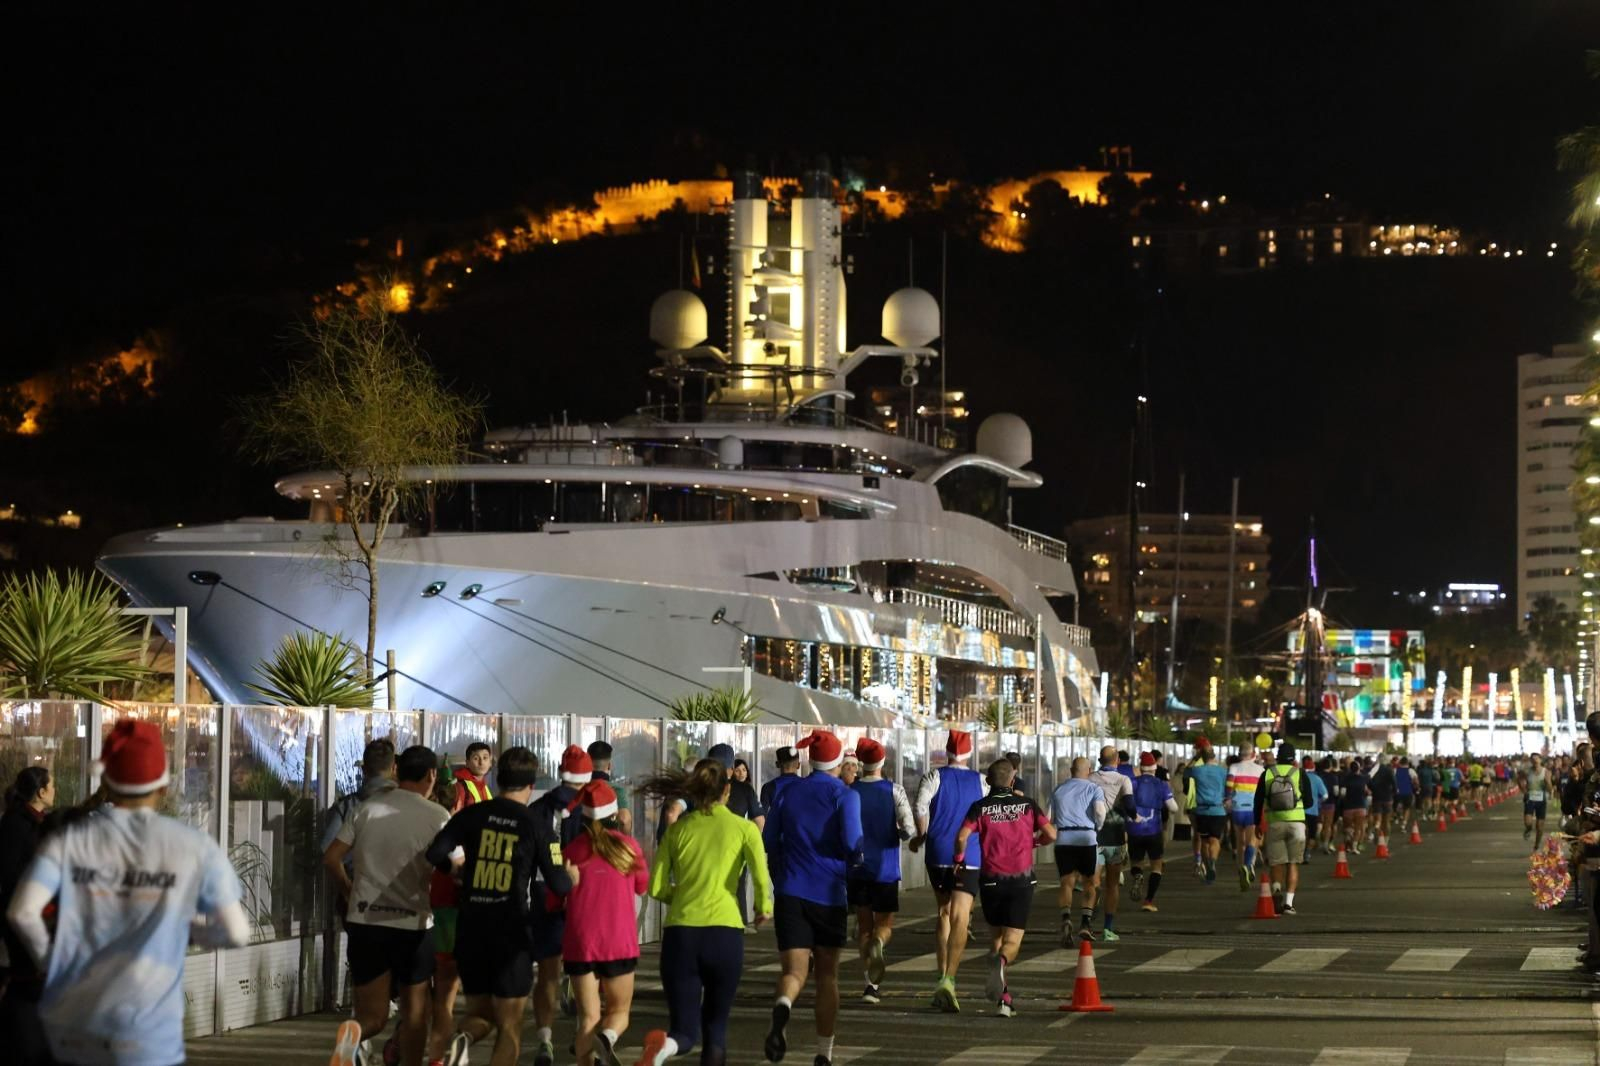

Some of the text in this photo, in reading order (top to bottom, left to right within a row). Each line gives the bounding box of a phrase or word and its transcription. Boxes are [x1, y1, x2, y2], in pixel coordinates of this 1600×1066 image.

[1002, 802, 1029, 815] SPORT
[488, 815, 518, 828] PEPE
[479, 828, 519, 862] RIT
[473, 860, 513, 892] MO
